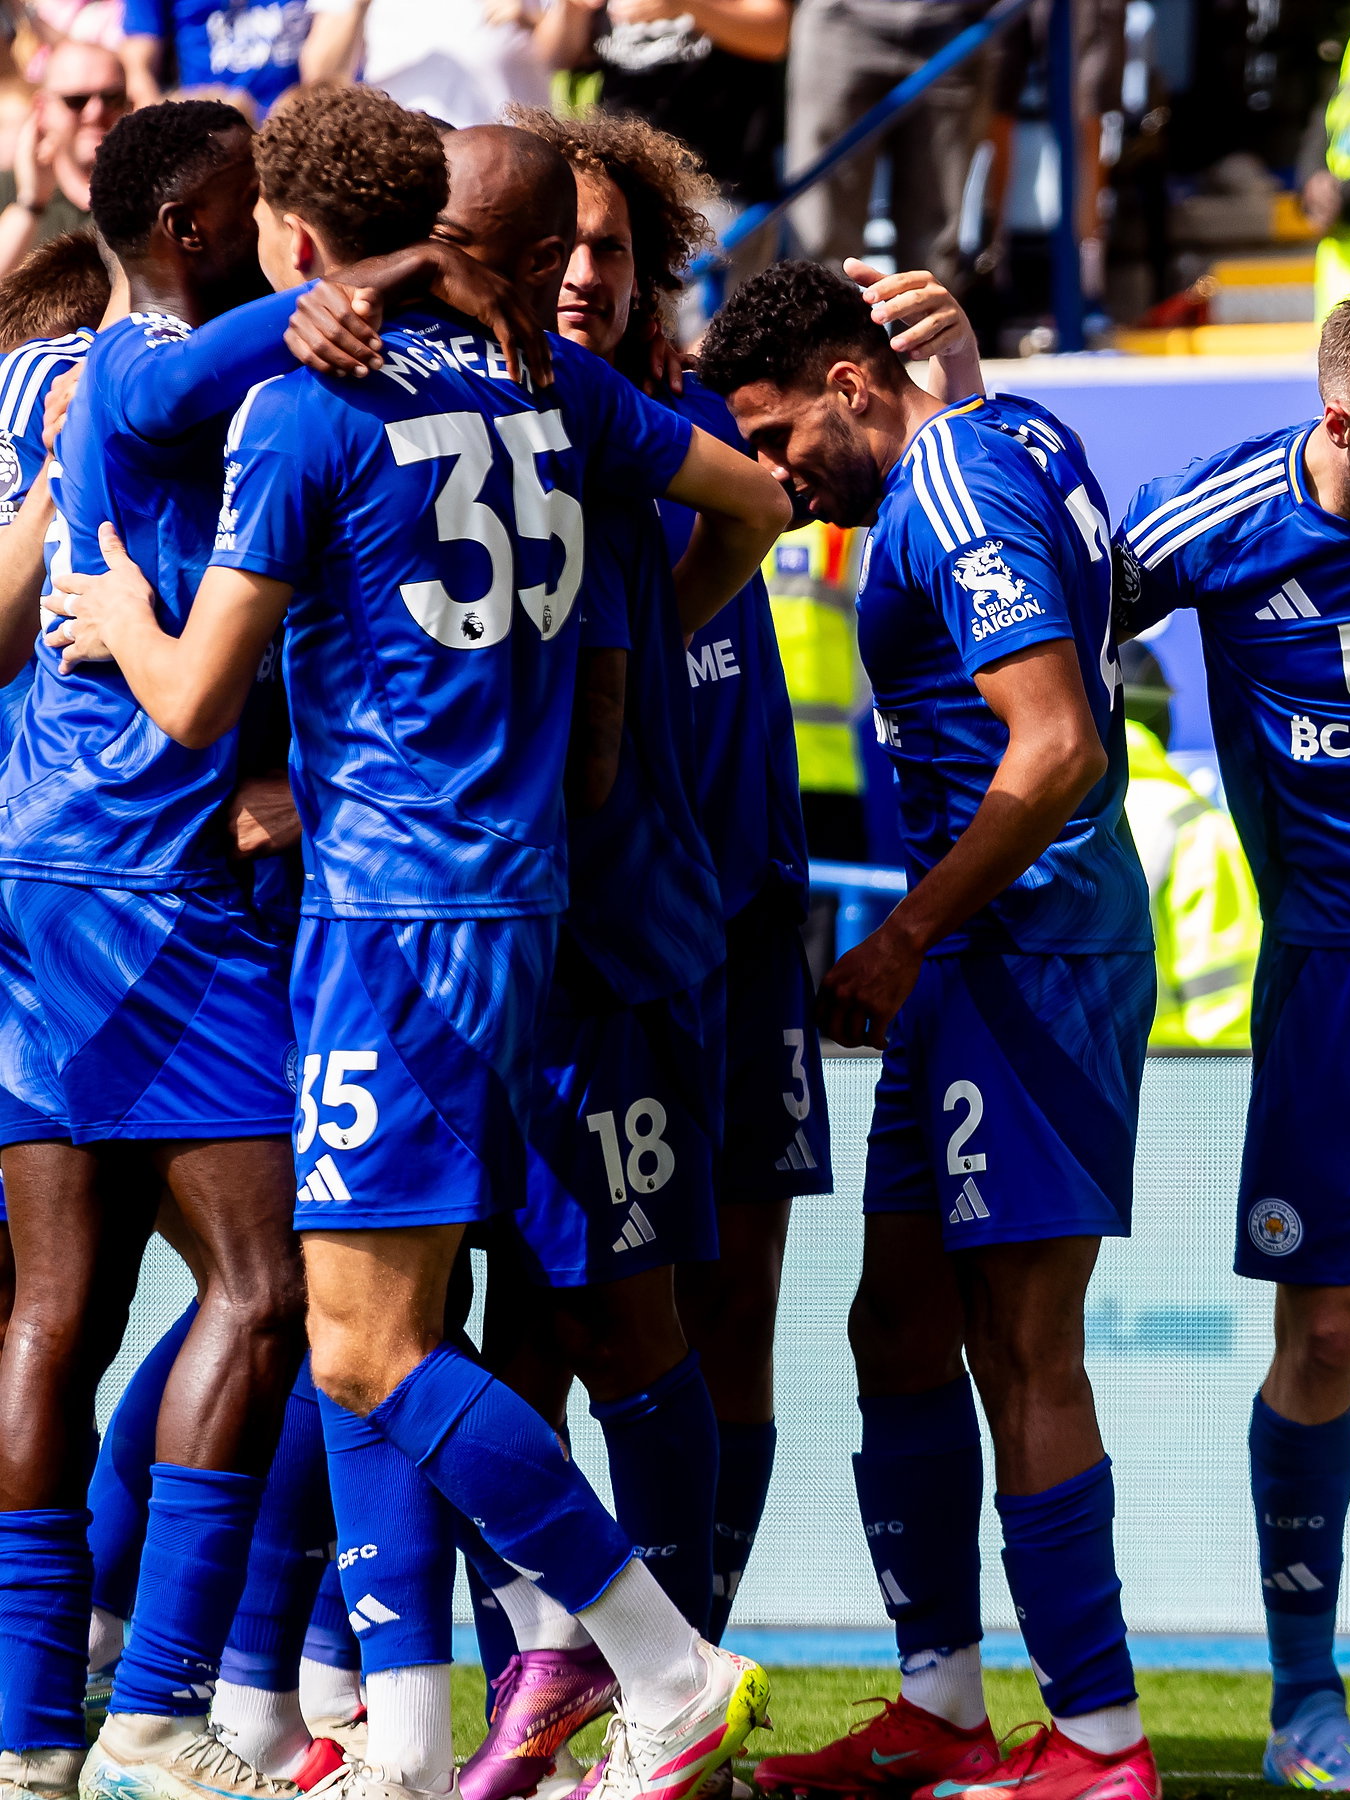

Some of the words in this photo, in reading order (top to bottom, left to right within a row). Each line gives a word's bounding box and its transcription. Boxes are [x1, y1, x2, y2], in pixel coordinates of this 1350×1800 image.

[384, 408, 584, 650] 35
[986, 598, 1011, 616] BIA
[686, 638, 741, 688] ME
[296, 1050, 378, 1151] 35
[782, 1028, 810, 1121] 3
[586, 1097, 676, 1205] 18
[943, 1079, 987, 1175] 2
[337, 1543, 378, 1571] CFC
